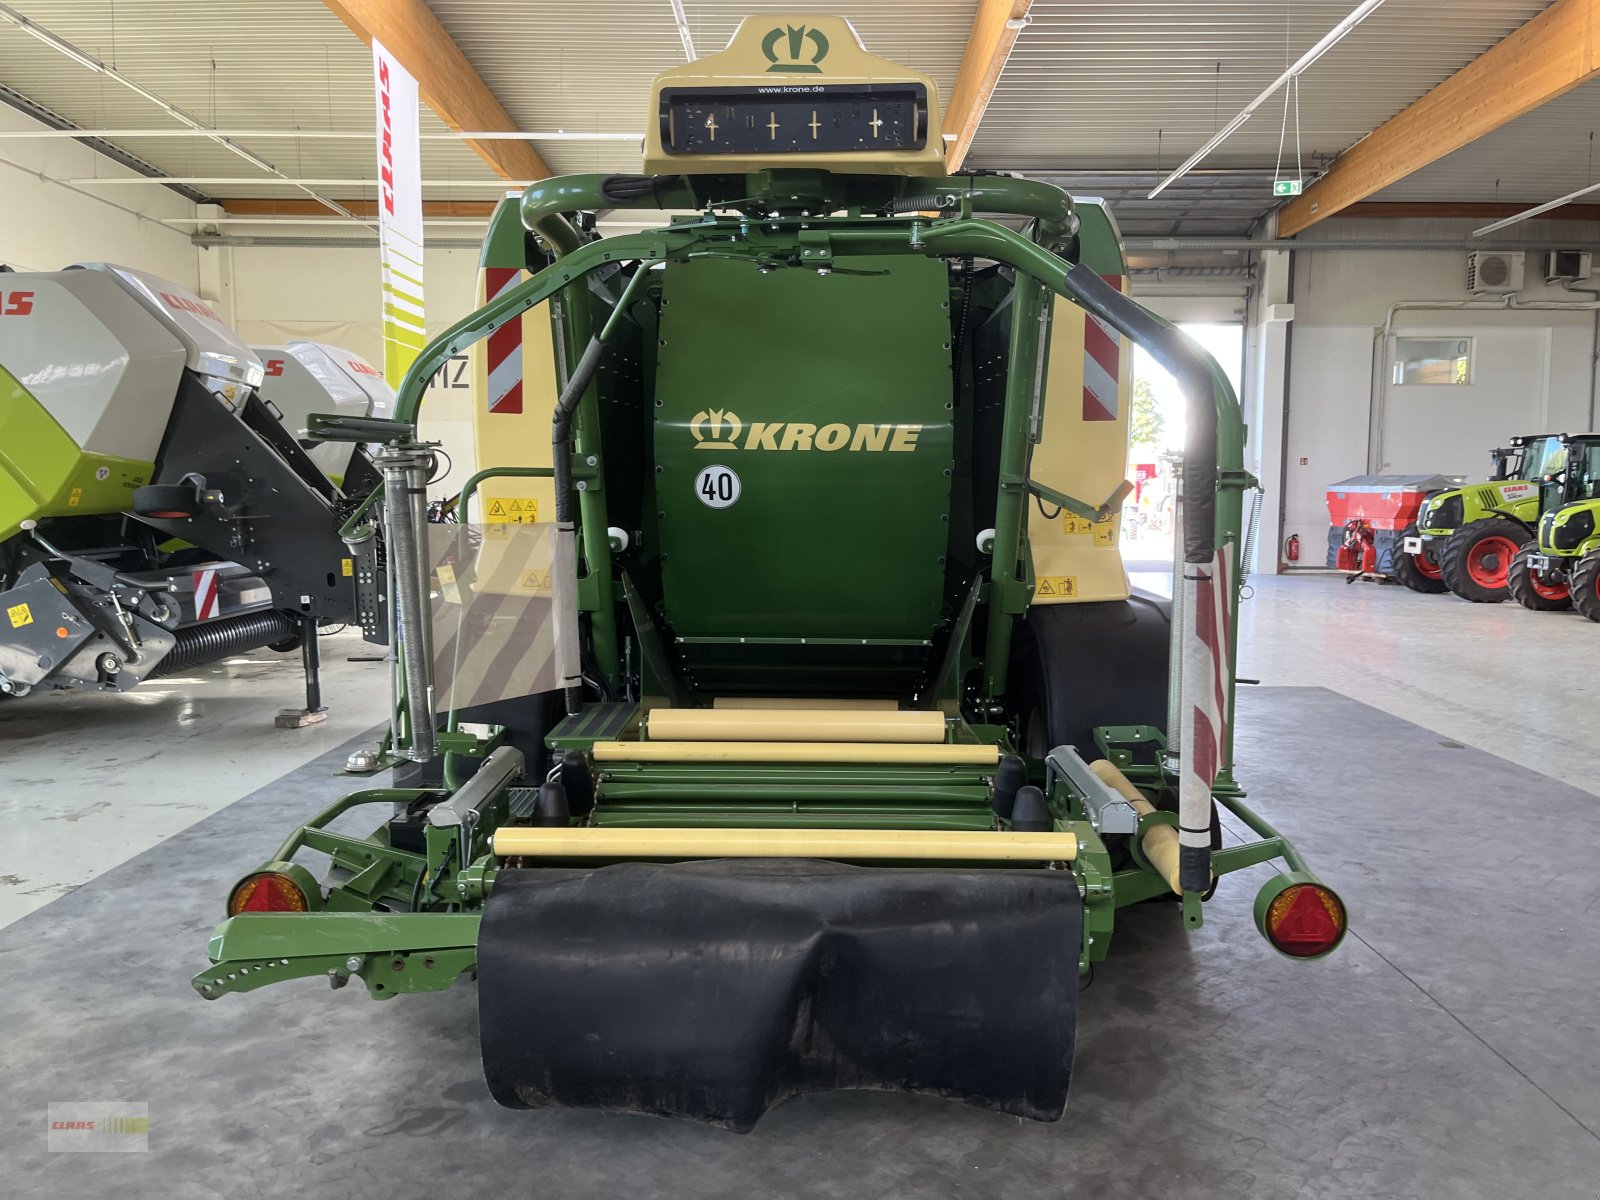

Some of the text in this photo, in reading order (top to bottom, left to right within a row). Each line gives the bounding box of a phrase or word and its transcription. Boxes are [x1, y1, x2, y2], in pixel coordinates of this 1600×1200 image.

[379, 55, 395, 217] CLAAS
[0, 291, 35, 315] S
[744, 422, 923, 452] KRONE
[702, 473, 733, 501] 40
[1503, 485, 1529, 493] CLAAS
